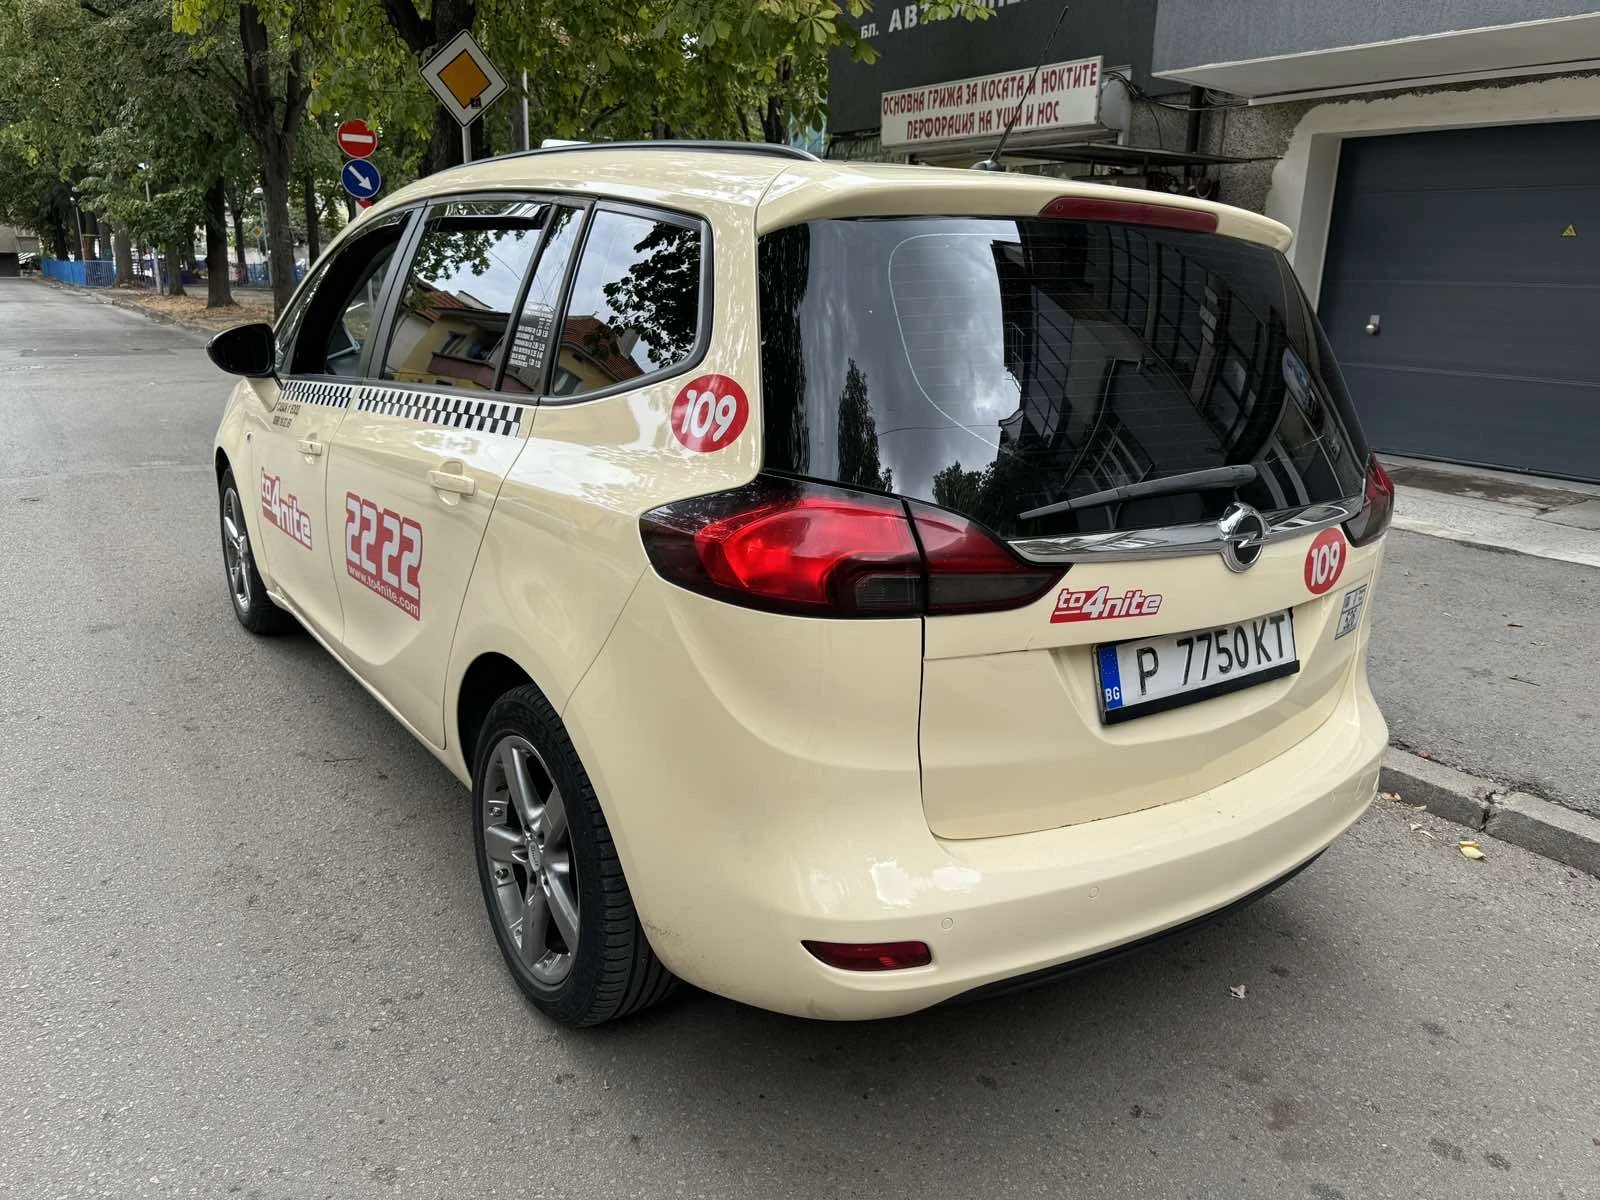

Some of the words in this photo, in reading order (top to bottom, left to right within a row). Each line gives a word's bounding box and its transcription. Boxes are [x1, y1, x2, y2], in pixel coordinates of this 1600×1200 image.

[882, 91, 925, 116] ОСНОВНА
[928, 85, 963, 109] ГРИЖА
[965, 82, 978, 105] ЗА
[981, 75, 1024, 102] КОСАТА
[1028, 73, 1036, 96] И
[1041, 63, 1097, 95] НОКТИТЕ
[907, 112, 975, 140] ПЕРФОРАЦИЯ
[979, 110, 992, 133] НА
[1026, 104, 1034, 126] И
[1037, 101, 1060, 125] НОС
[681, 389, 737, 442] 109
[261, 467, 312, 546] to4nite
[1310, 546, 1339, 587] 109
[348, 565, 420, 617] www.to4nite.com
[1055, 586, 1163, 621] to4nite
[1105, 687, 1121, 703] BG
